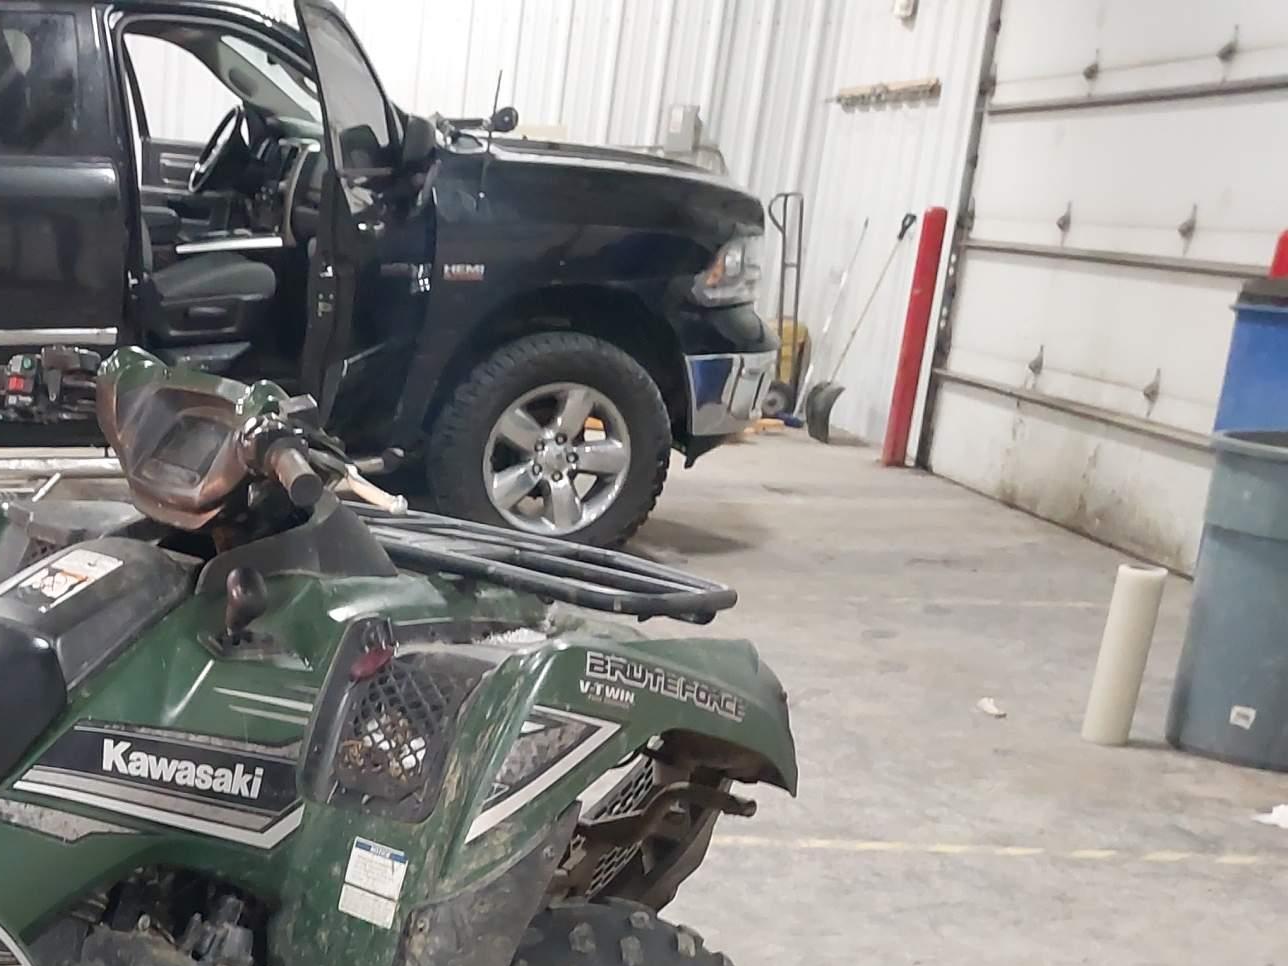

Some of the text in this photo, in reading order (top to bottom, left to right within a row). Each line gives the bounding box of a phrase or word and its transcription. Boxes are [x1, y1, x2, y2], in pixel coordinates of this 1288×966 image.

[443, 263, 485, 275] HEMI
[579, 679, 635, 704] V-TWIN
[585, 650, 746, 723] BRUTE FORCE
[102, 738, 264, 799] Kawasaki
